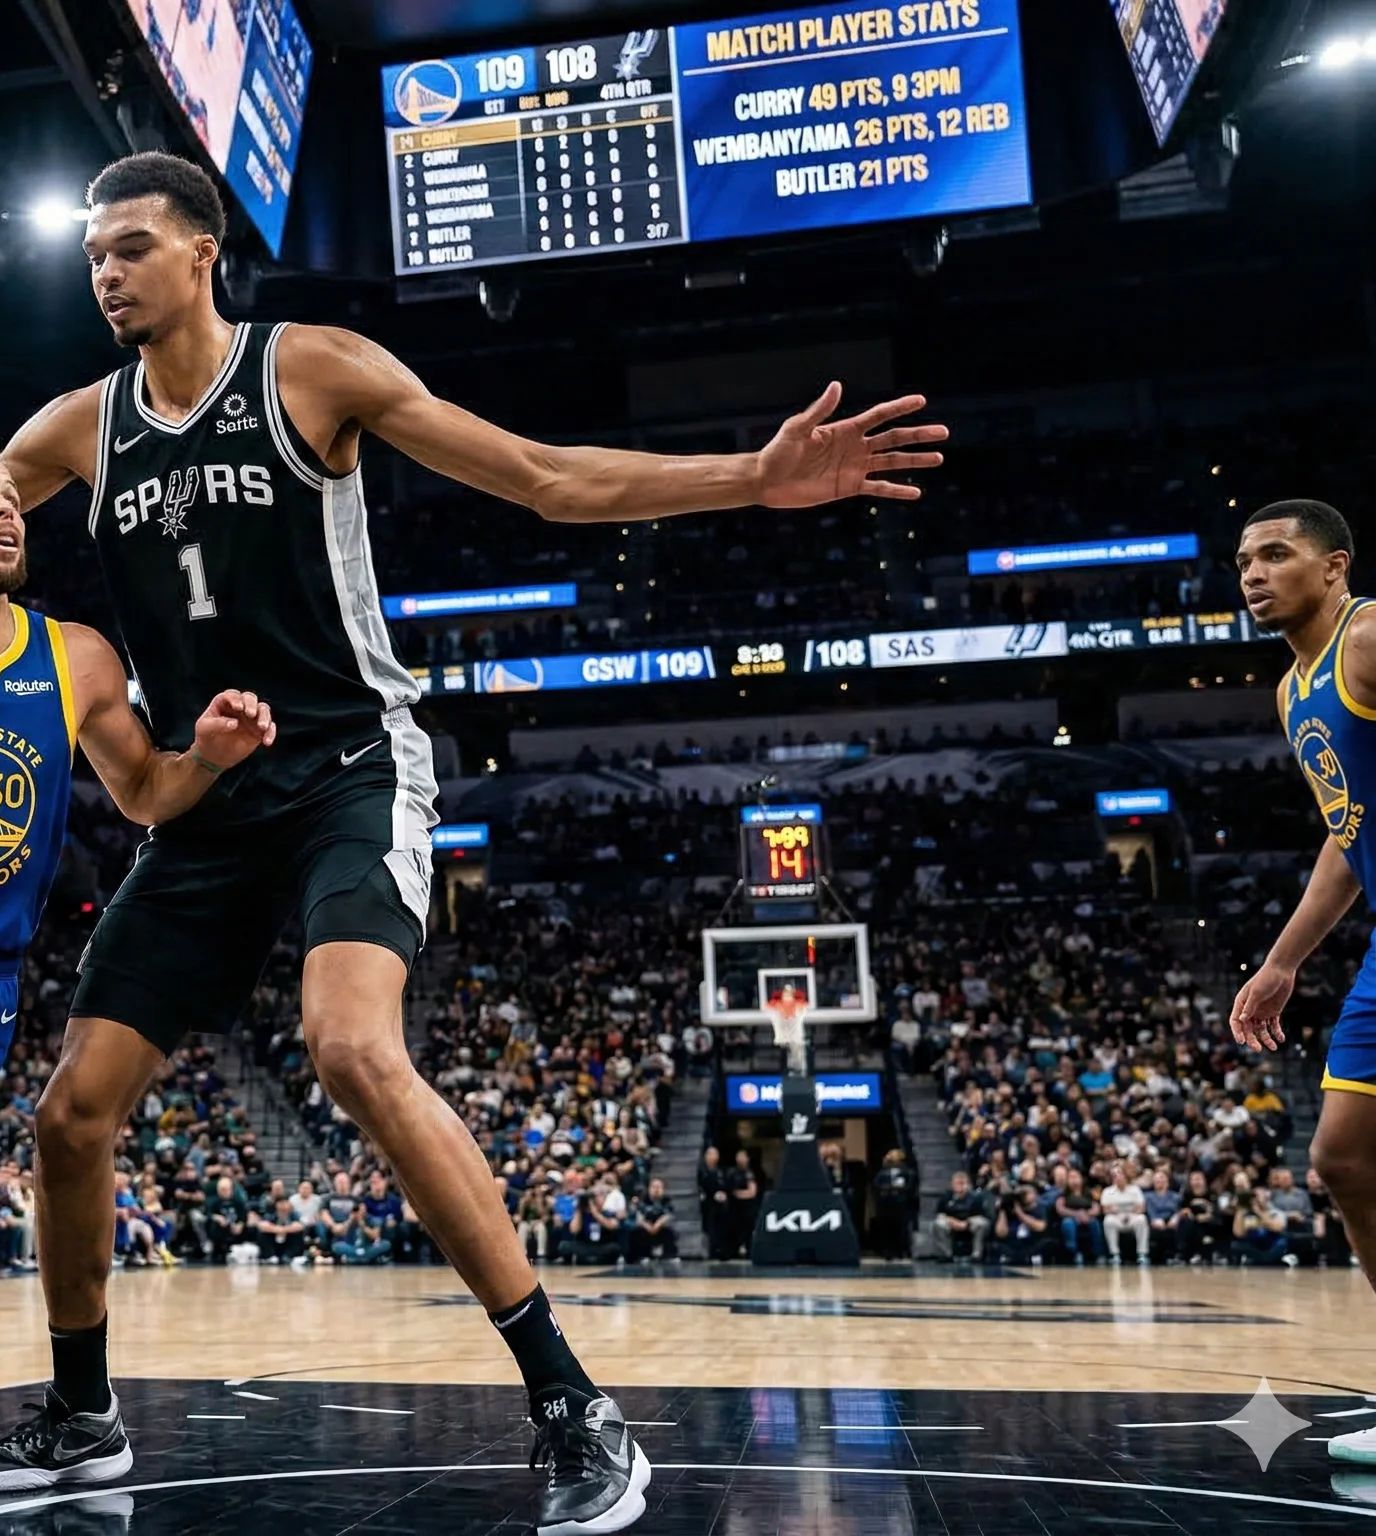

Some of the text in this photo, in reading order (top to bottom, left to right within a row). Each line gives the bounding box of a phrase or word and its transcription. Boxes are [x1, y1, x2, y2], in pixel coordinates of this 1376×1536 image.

[706, 0, 980, 62] MATCH PLAYER STATS
[476, 55, 525, 93] 109
[546, 44, 597, 83] 108
[734, 66, 961, 121] CURRY 49 PTS, 9 3PM
[693, 102, 1010, 166] WEMBANYAMA 26 PTS, 12 REB
[776, 154, 929, 197] BUTLER 21 PTS
[114, 464, 274, 539] SPURS
[178, 543, 217, 621] 1
[582, 655, 637, 682] GSW
[655, 651, 703, 678] 109
[816, 638, 866, 667] 108
[888, 636, 934, 660] SAS
[4, 679, 54, 694] Rakuten
[770, 849, 802, 879] 14
